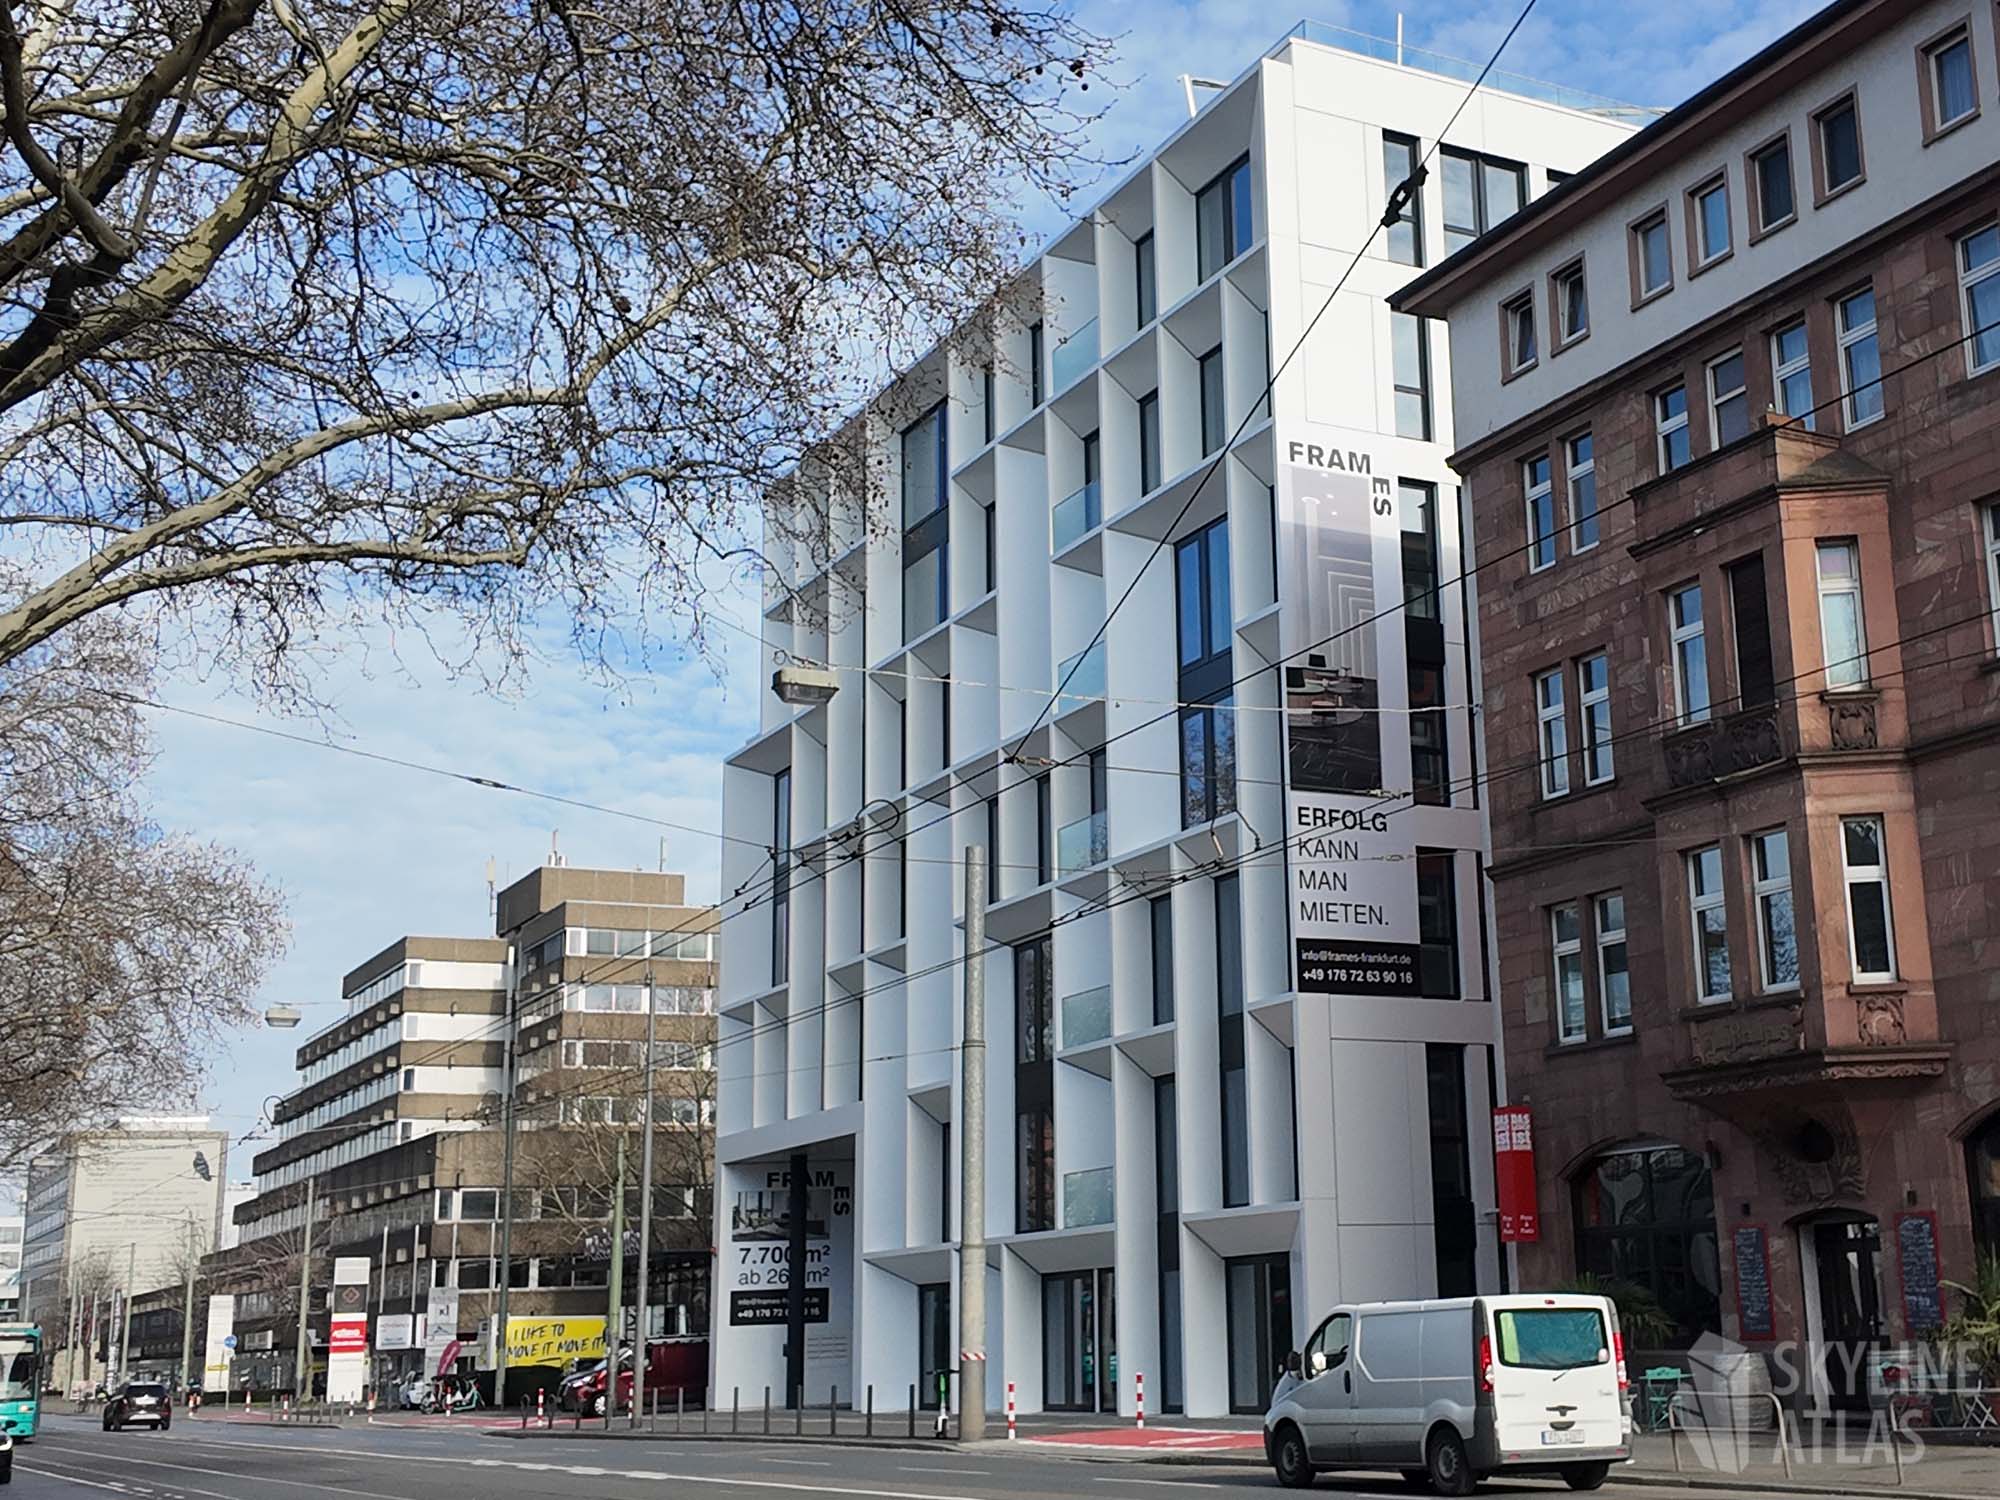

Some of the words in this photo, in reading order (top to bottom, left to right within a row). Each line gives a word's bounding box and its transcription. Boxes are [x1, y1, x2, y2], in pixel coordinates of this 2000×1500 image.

[1289, 441, 1371, 475] FRAM
[1372, 477, 1392, 516] ES
[1297, 806, 1388, 832] ERFOLG
[1298, 837, 1359, 860] KANN
[1299, 869, 1347, 891] MAN
[1300, 901, 1389, 926] MIETEN.
[1301, 950, 1412, 965] info@frames-frankfurt.de
[1302, 968, 1324, 981] +49
[1327, 969, 1347, 981] 176
[1350, 970, 1364, 982] 72
[1400, 972, 1413, 984] 16
[738, 1269, 761, 1285] ab
[521, 1325, 548, 1341] LIKE
[552, 1323, 565, 1337] TO
[506, 1343, 540, 1359] MOVE
[542, 1340, 554, 1356] IT
[557, 1337, 590, 1353] MOVE
